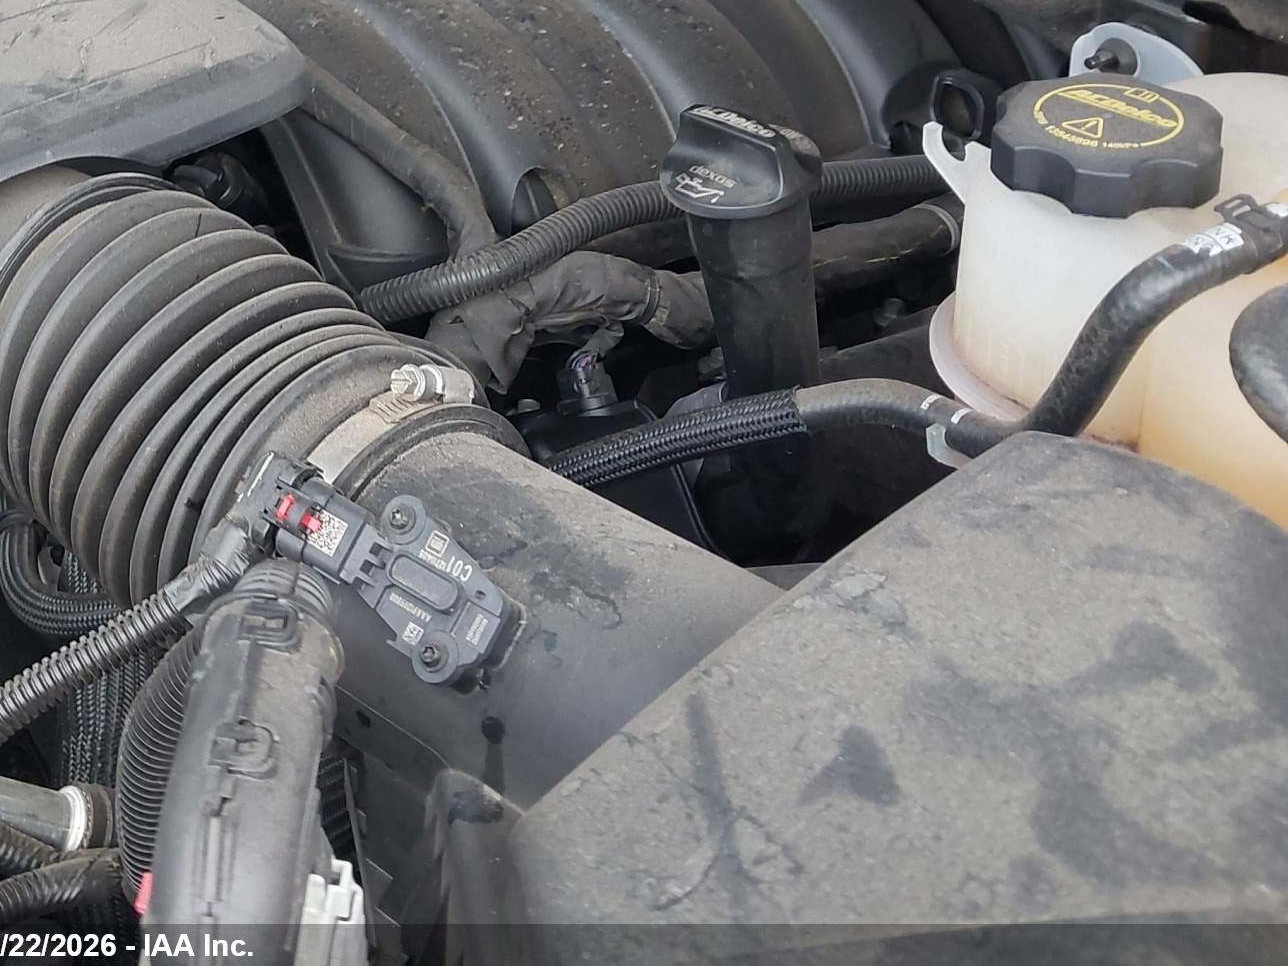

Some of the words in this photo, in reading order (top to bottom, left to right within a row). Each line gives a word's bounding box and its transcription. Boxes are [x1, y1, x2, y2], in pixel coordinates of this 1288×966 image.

[688, 105, 776, 139] ACDelco
[1057, 89, 1178, 128] ACDelco
[688, 164, 737, 189] dexos
[445, 555, 473, 582] C01
